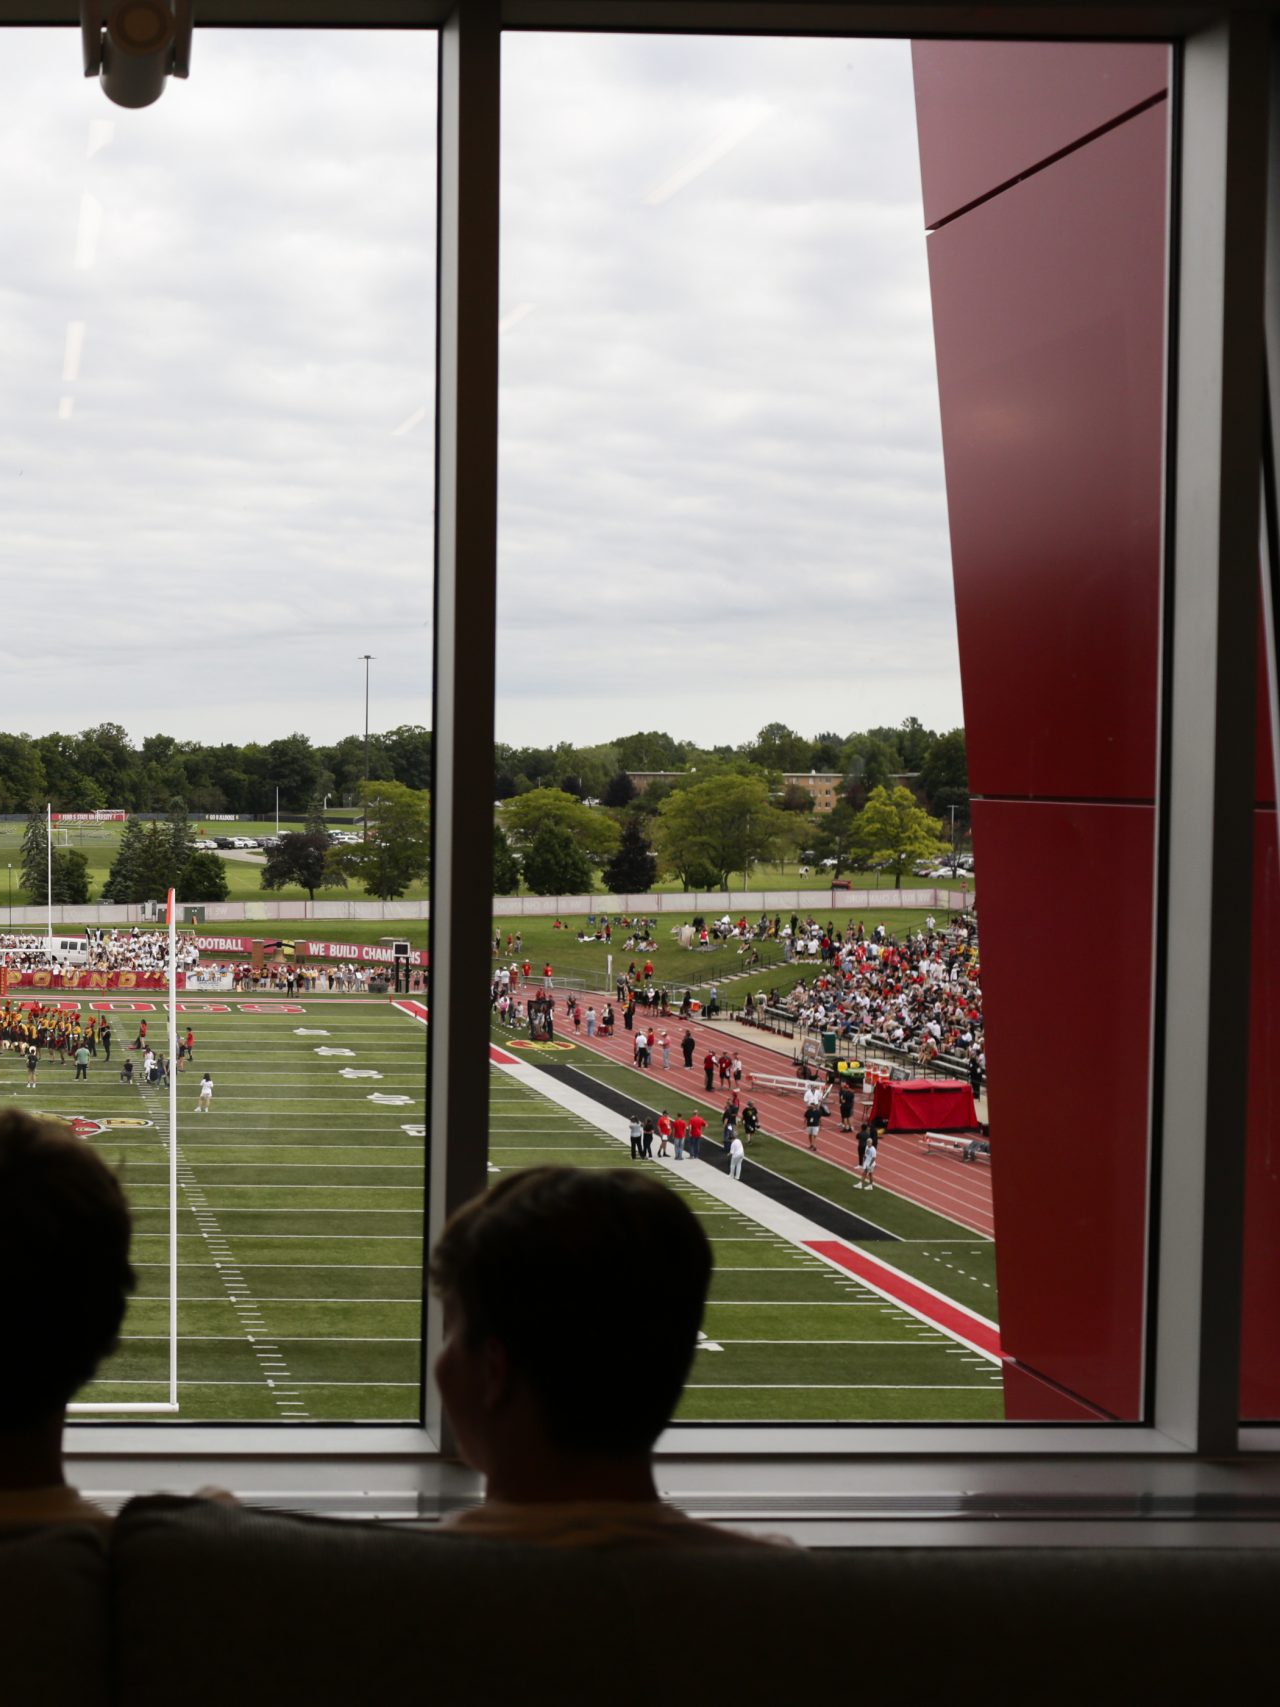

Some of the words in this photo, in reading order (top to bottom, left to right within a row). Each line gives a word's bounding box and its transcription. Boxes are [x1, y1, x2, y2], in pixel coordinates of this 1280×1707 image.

[309, 943, 325, 956] WE
[329, 944, 359, 958] BUILD
[362, 946, 421, 965] CHAMNS
